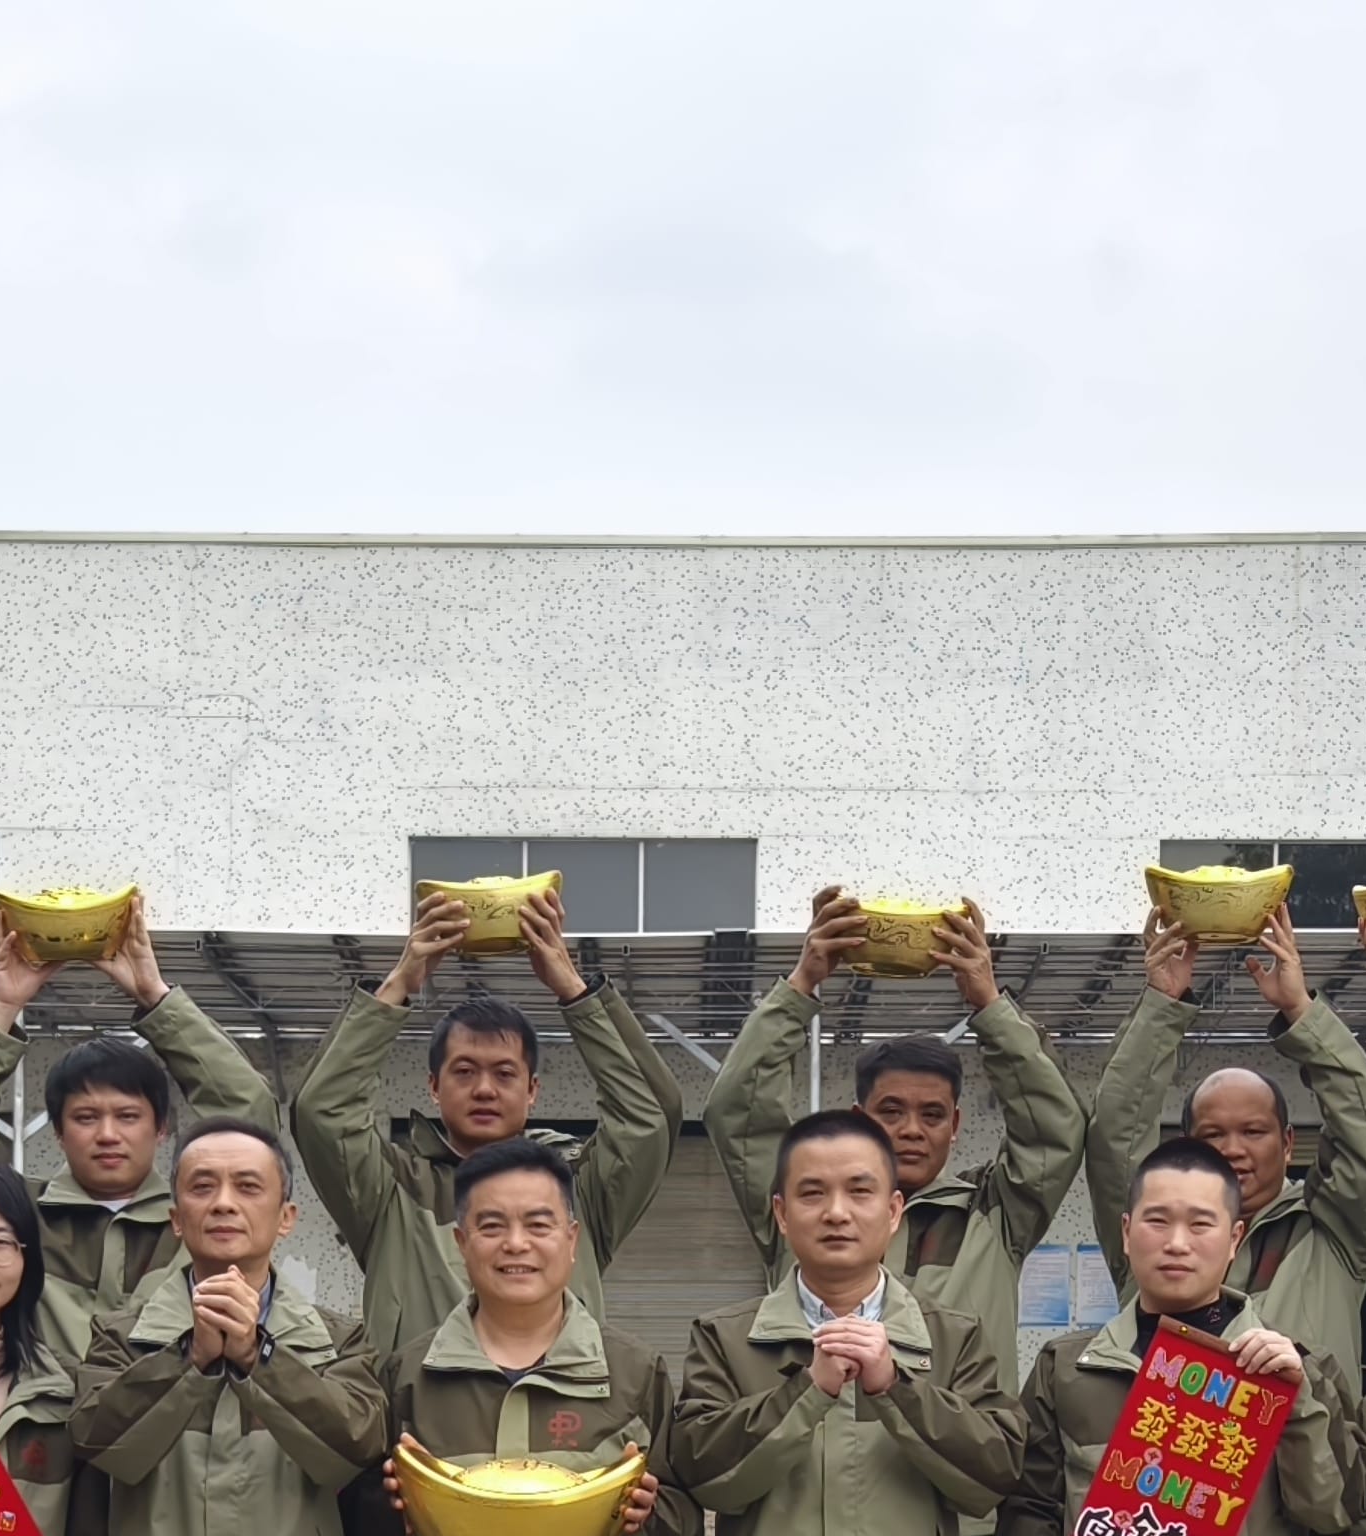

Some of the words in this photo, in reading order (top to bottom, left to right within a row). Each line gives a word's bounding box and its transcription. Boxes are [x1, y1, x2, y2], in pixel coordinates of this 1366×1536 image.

[1147, 1346, 1289, 1426] MONEY
[1131, 1396, 1258, 1478] 發發發
[1101, 1449, 1246, 1527] MONEY
